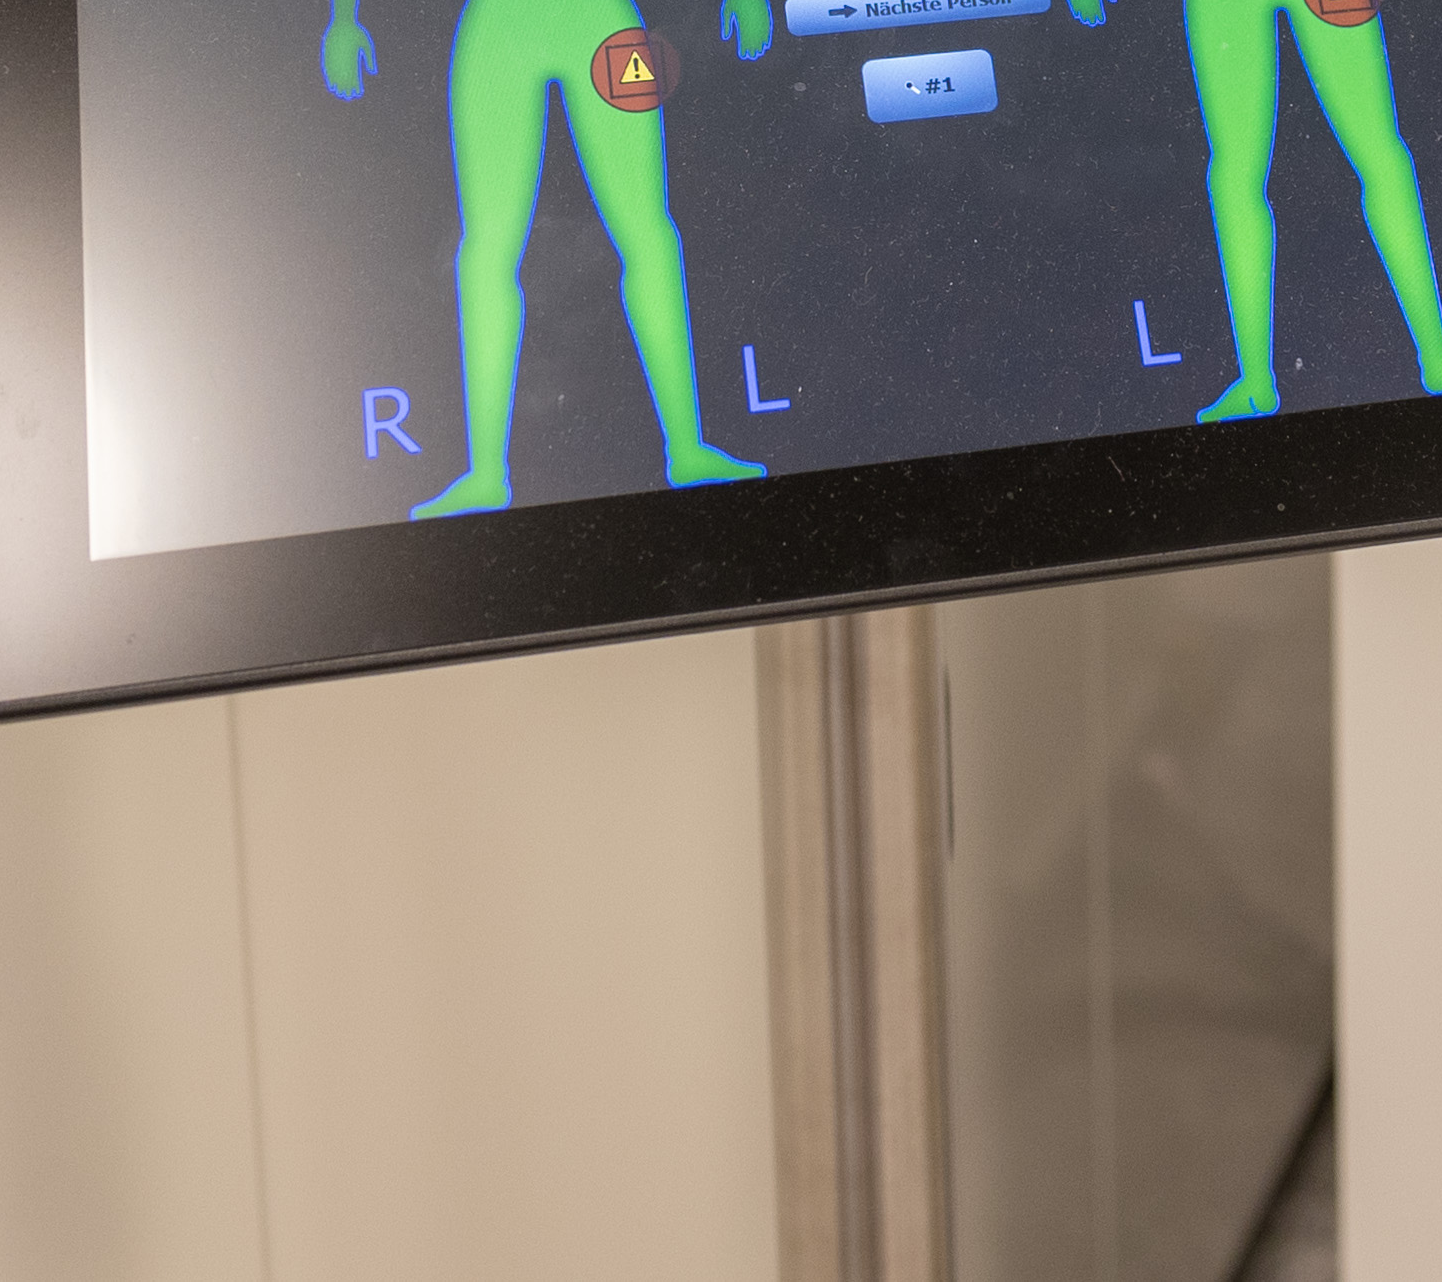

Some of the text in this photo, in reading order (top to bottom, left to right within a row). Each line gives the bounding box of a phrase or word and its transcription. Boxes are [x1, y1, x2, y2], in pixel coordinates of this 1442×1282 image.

[925, 77, 956, 94] #1
[1133, 299, 1182, 367] L
[742, 344, 791, 414] L
[362, 386, 422, 459] R
